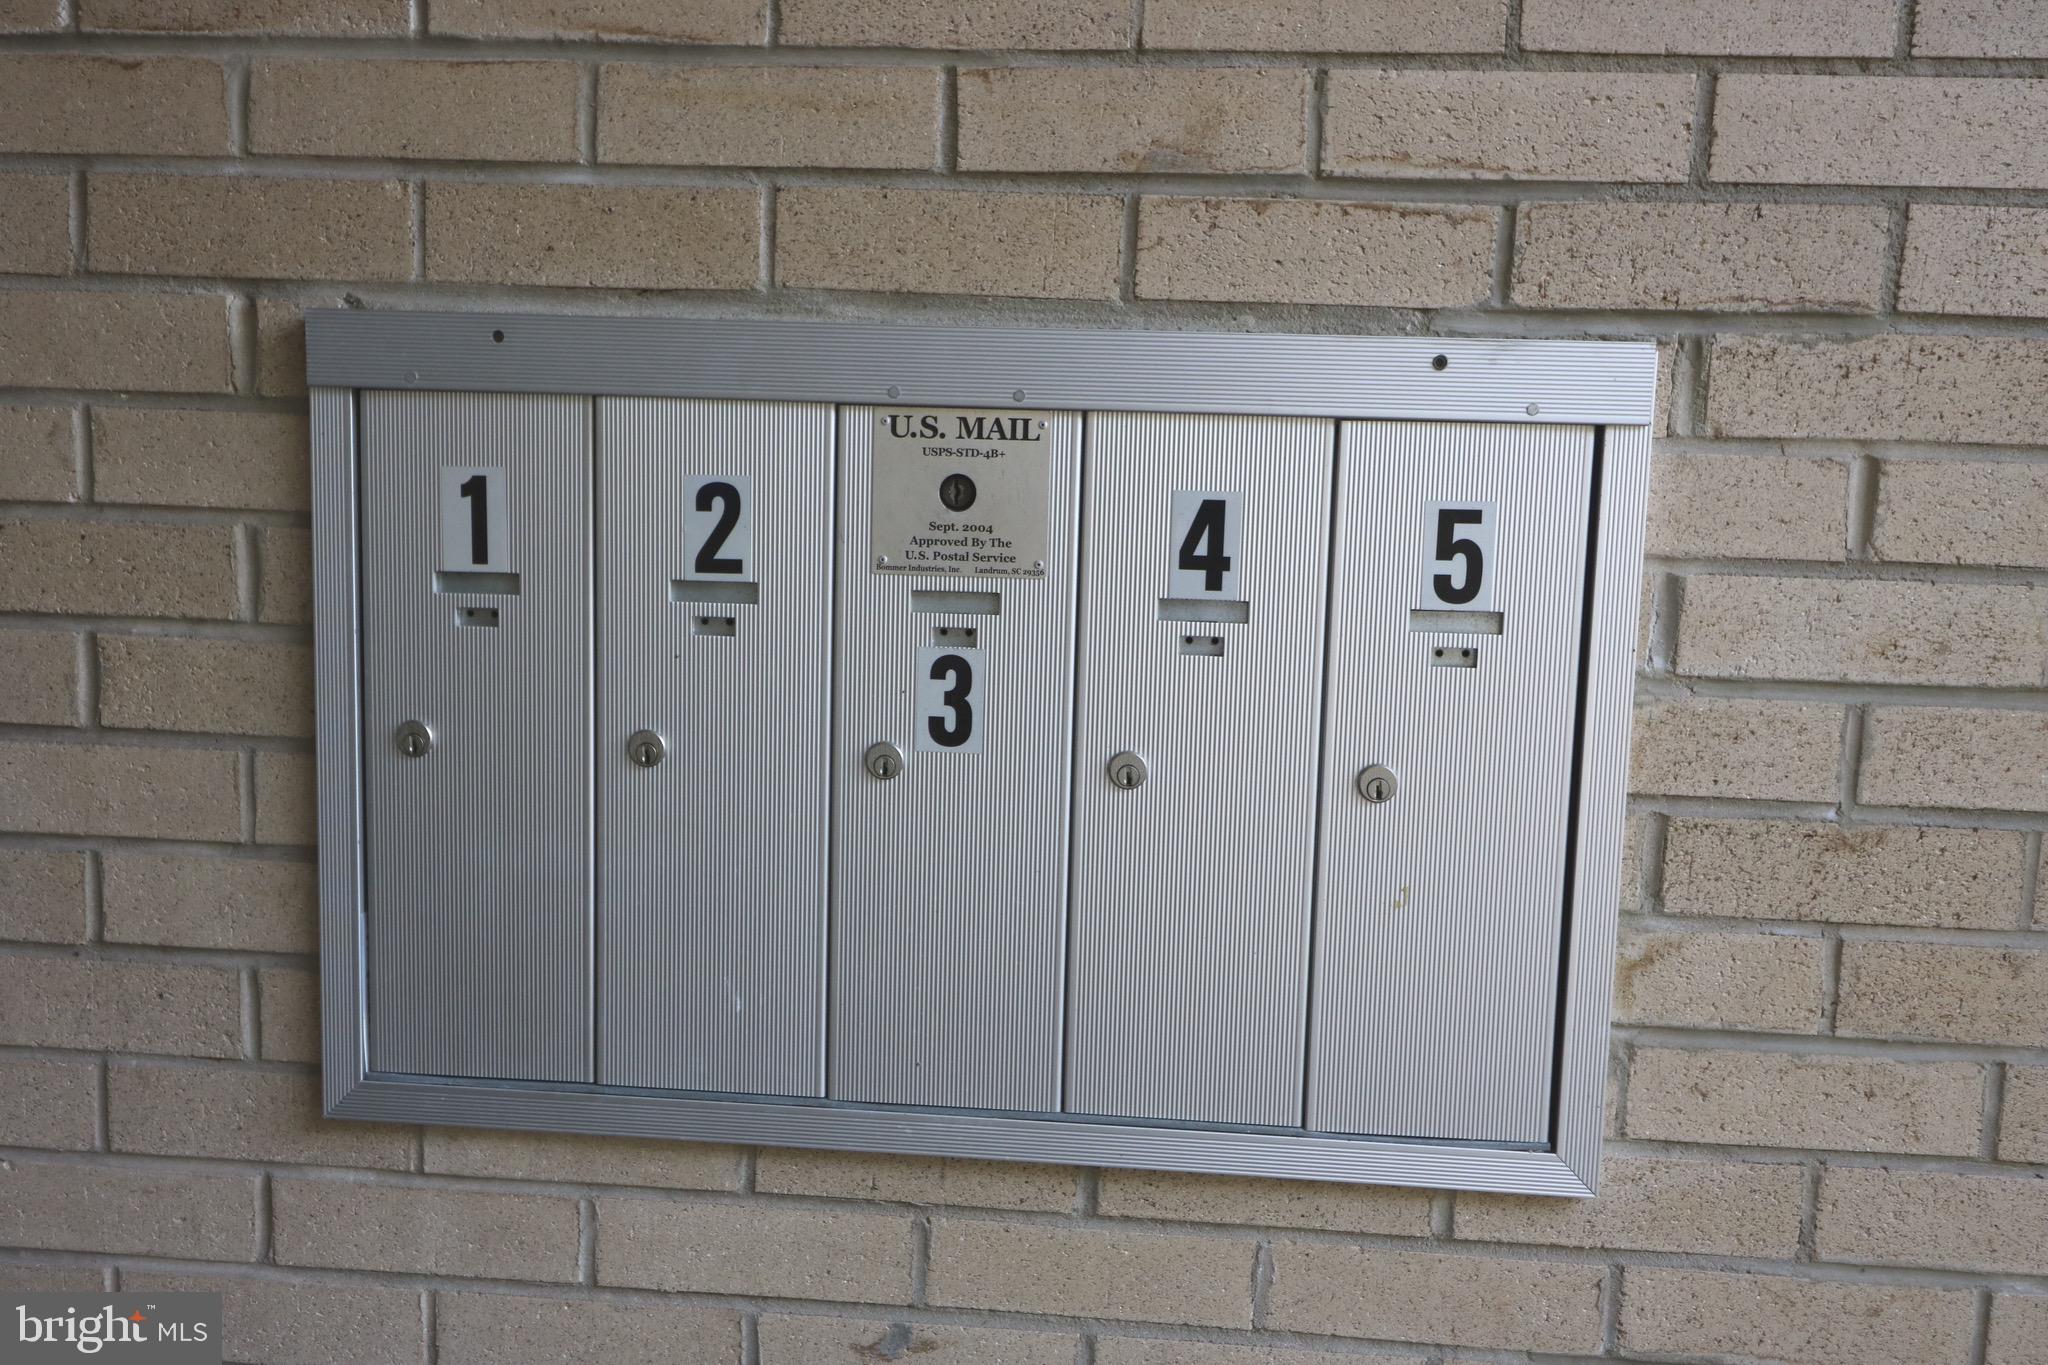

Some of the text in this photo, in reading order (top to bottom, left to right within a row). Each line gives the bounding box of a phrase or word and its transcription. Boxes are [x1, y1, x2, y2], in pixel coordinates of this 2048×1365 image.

[888, 414, 1041, 442] U.S. MAIL
[922, 447, 1006, 460] USPS-STD-4B+
[460, 475, 488, 564] 1
[694, 482, 743, 574] 2
[909, 536, 1012, 549] Approved By The
[928, 521, 993, 534] Sept. 2004
[1179, 499, 1231, 591] 4
[905, 550, 1016, 563] U.S. Postal Service
[1433, 509, 1484, 604] 5
[927, 654, 973, 747] 3
